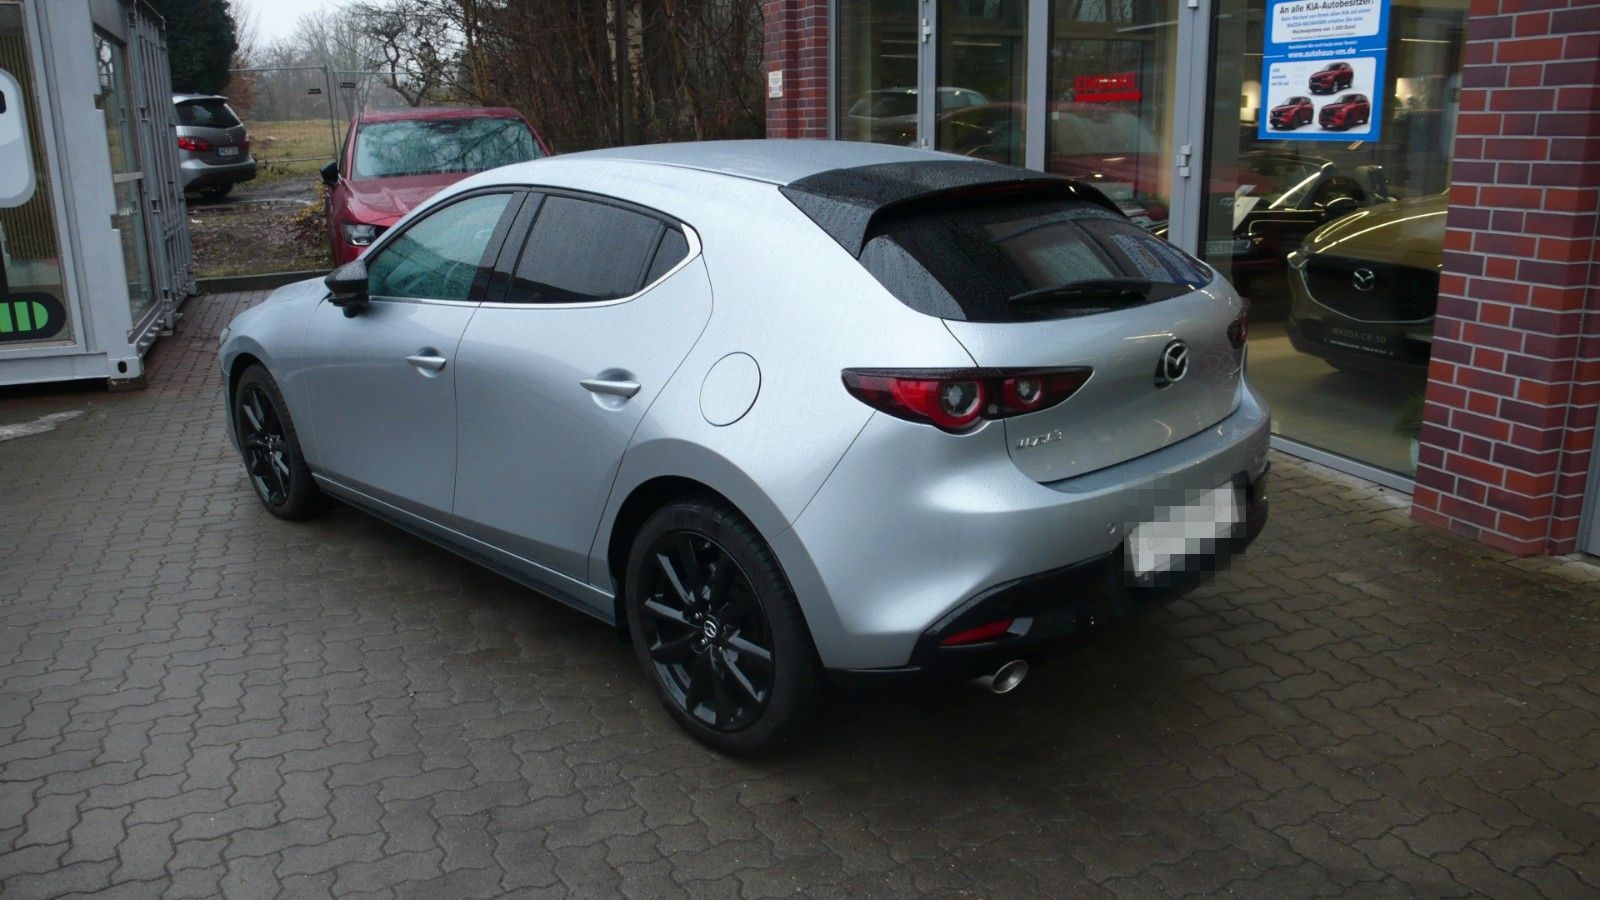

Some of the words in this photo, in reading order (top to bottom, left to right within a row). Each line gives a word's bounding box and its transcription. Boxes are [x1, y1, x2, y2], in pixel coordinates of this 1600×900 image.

[1279, 6, 1289, 14] An
[1291, 4, 1304, 13] alle
[1288, 47, 1357, 58] www.autohaus-vm.de
